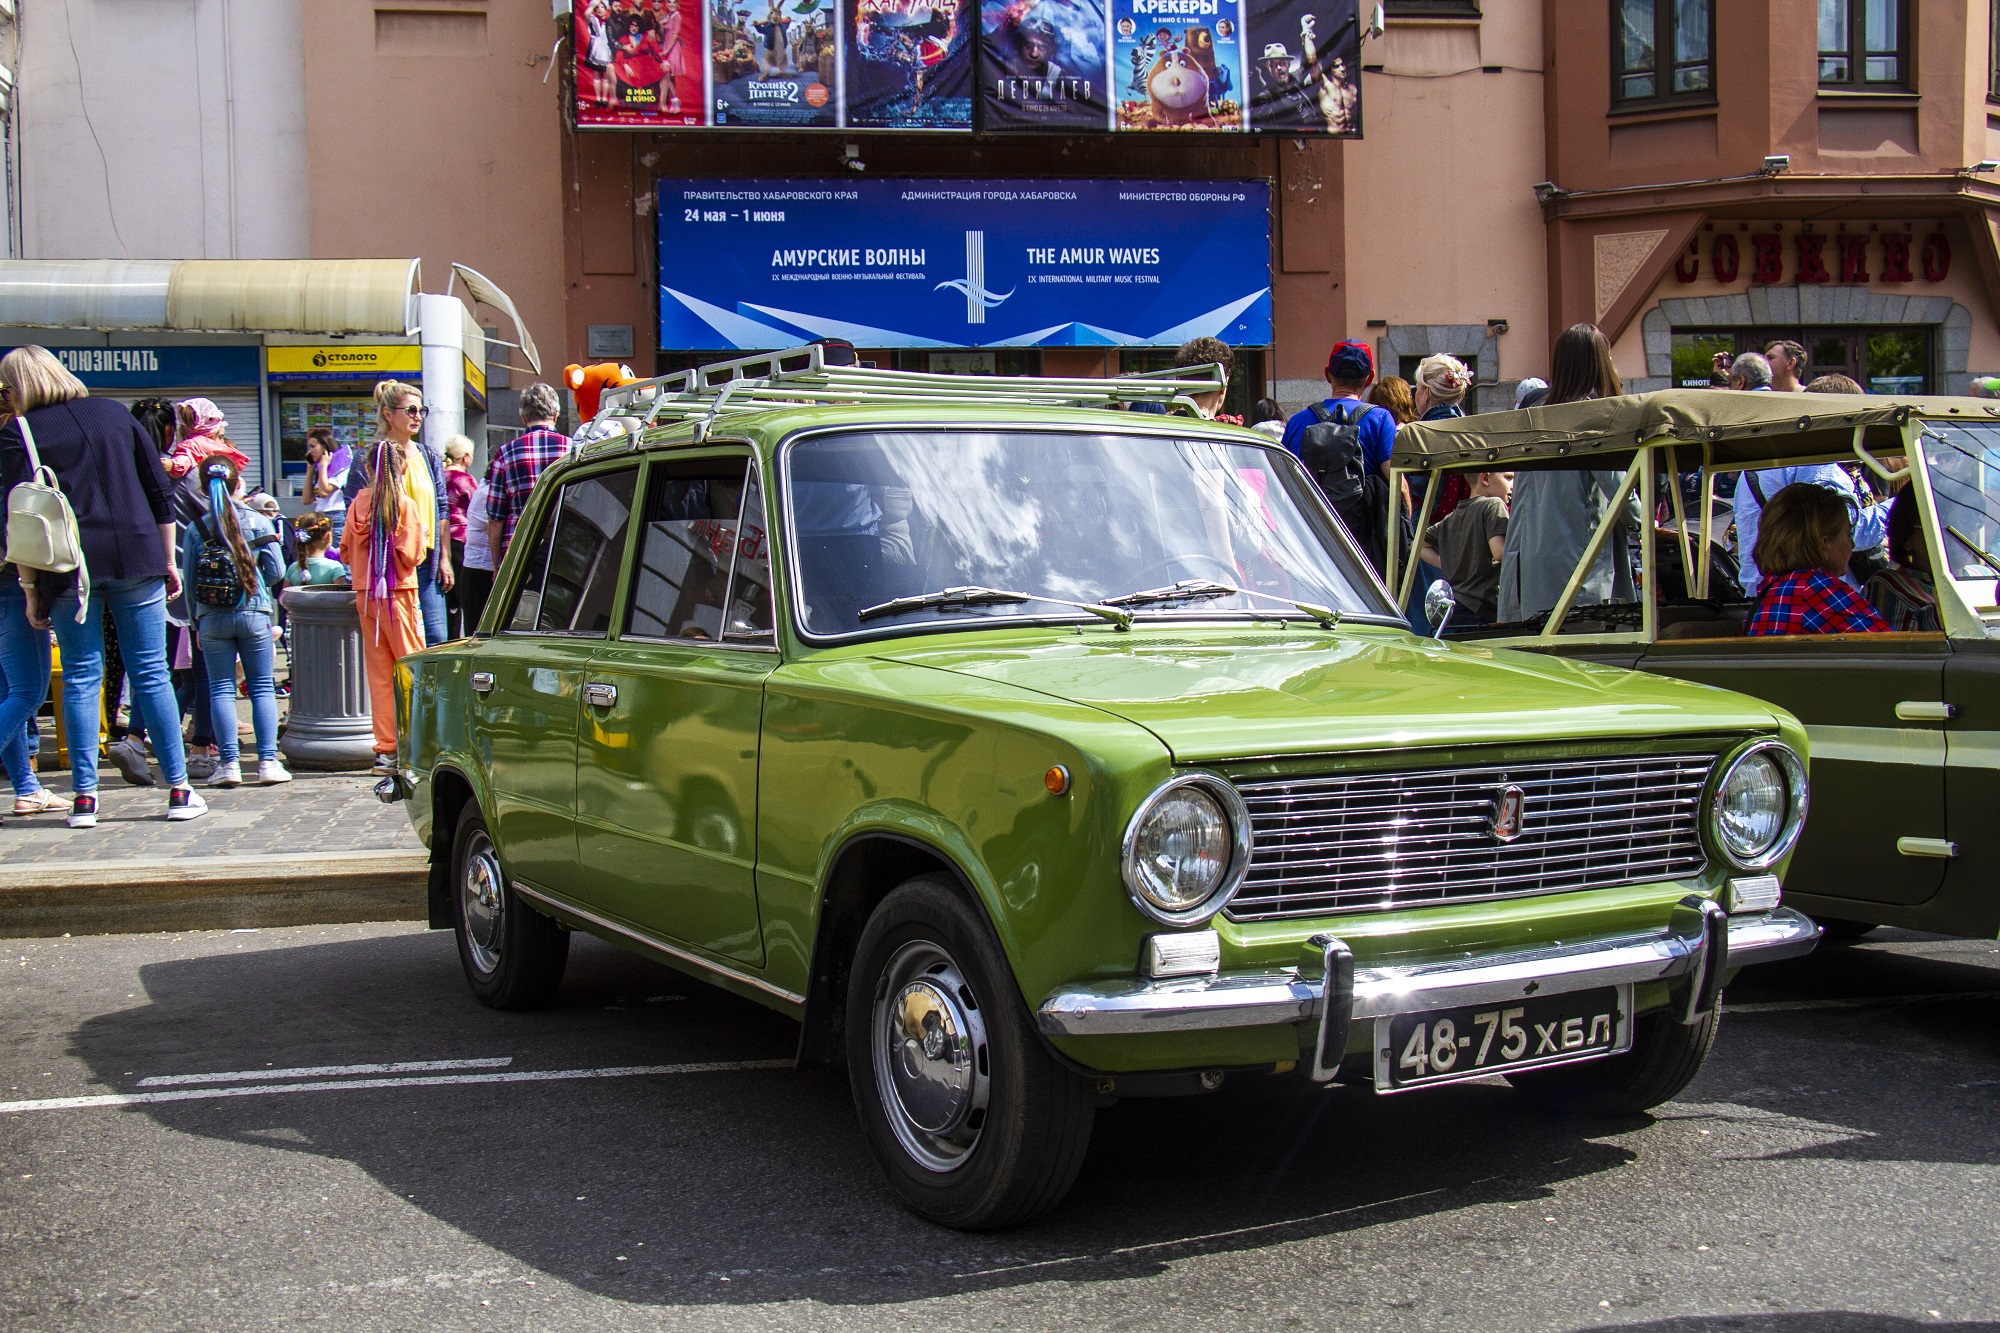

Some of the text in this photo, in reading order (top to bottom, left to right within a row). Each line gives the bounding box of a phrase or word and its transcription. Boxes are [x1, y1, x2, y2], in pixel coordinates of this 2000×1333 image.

[1133, 0, 1218, 14] КРЕКЕРЫ
[748, 81, 786, 90] КРОЛИК
[997, 80, 1091, 100] ДЕВЯТАЕВ
[748, 89, 788, 99] ПИТЕР
[788, 82, 798, 103] 2
[716, 99, 729, 110] 6+
[684, 191, 858, 200] ПРАВИТЕЛЬСТВО ХАБАРОВСКОГО КРАЯ
[901, 191, 1077, 200] АДМИНИСТРАЦИЯ ГОРОДА ХАБАРОВСКА
[1119, 192, 1245, 201] МИНИСТЕРСТВО ОБОРОНЫ РФ
[684, 209, 700, 222] 24
[704, 211, 726, 222] мая
[743, 209, 749, 222] 1
[753, 211, 785, 222] июня
[771, 248, 926, 266] АМУРСКИЕ ВОЛНЫ
[1026, 248, 1160, 264] THE AMUR WAVES
[1675, 233, 1950, 283] СОВКИНО
[781, 272, 830, 281] МЕЖДУНАРОДНЫЙ
[831, 272, 894, 280] ВОЕННО-МУЗЫКАЛЬНЫЙ
[1028, 275, 1160, 284] IX INTERNATIONAL MILITARY MUSIC FESTIVAL
[58, 350, 159, 372] СОЮЗПЕЧАТЬ
[328, 353, 377, 361] СТОЛОТО
[1400, 1007, 1527, 1075] 48-75
